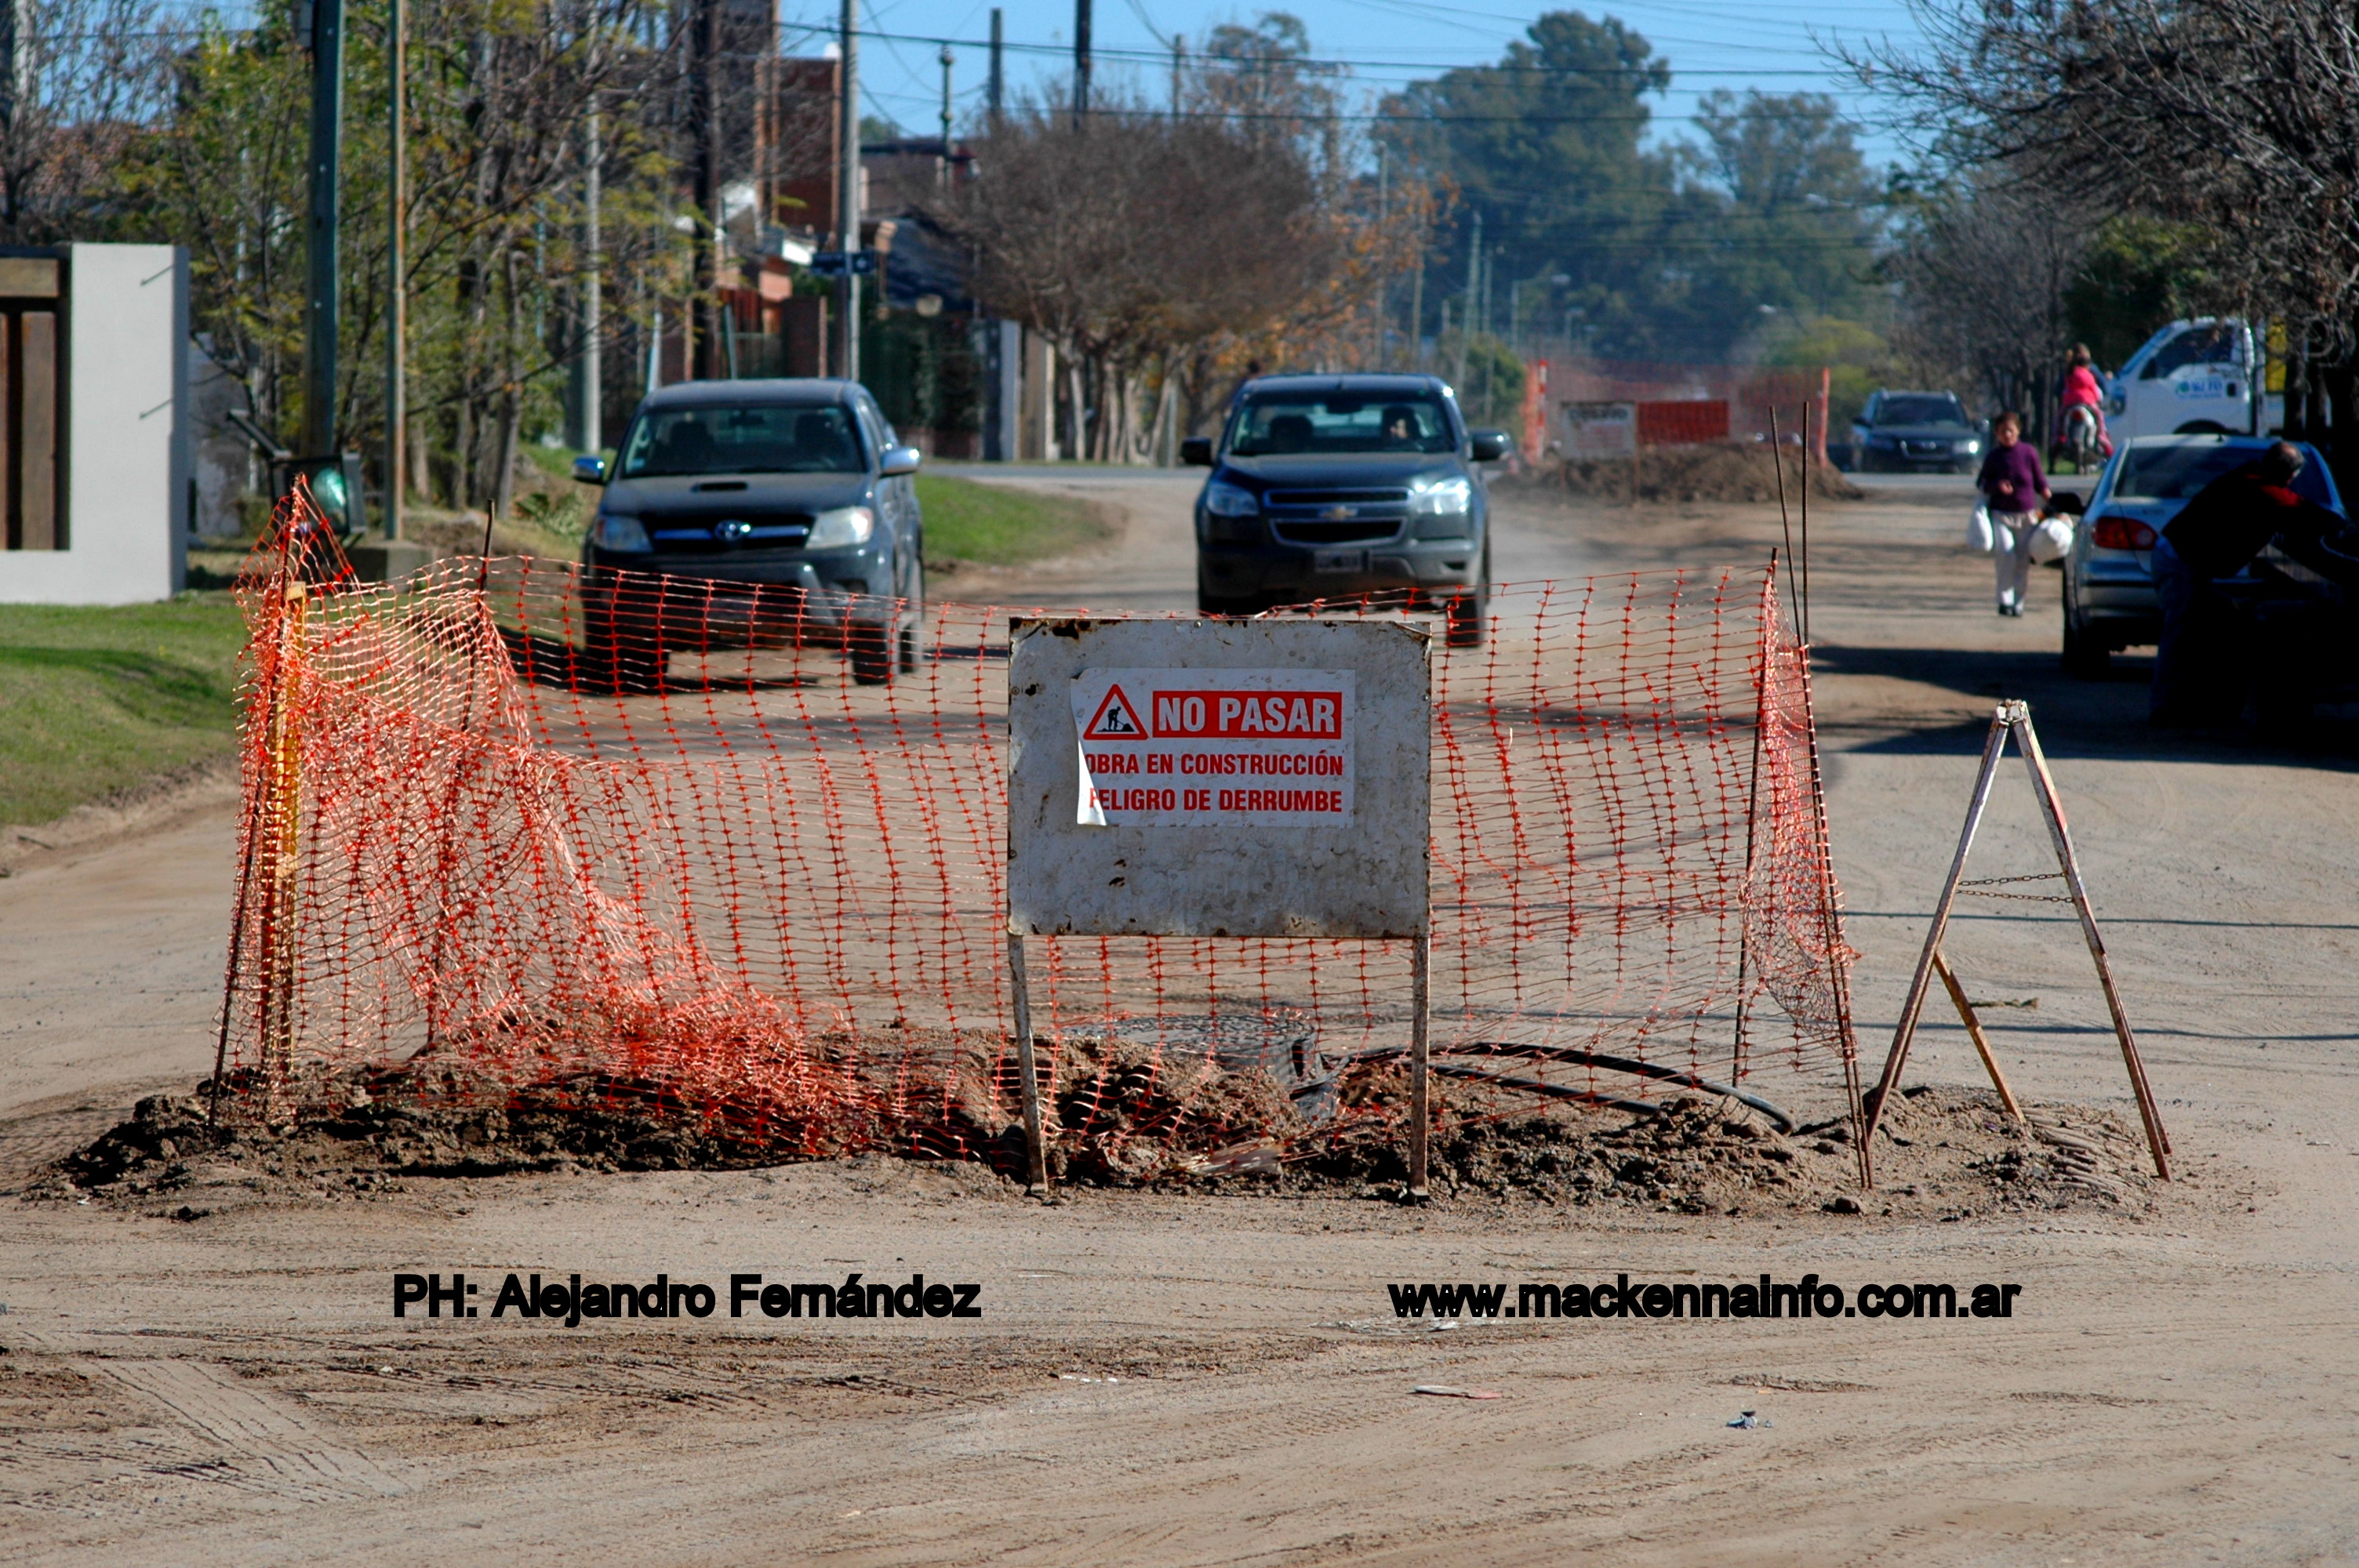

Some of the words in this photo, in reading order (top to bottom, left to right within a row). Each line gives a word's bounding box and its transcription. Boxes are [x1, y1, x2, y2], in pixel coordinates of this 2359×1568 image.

[1158, 697, 1205, 732] NO
[1219, 697, 1335, 733] PASAR
[1084, 753, 1140, 775] OBRA
[1147, 753, 1173, 774] EN
[1180, 750, 1343, 776] CONSTRUCCIÓN
[1183, 789, 1210, 811] DE
[1219, 789, 1342, 813] DERRUMBE
